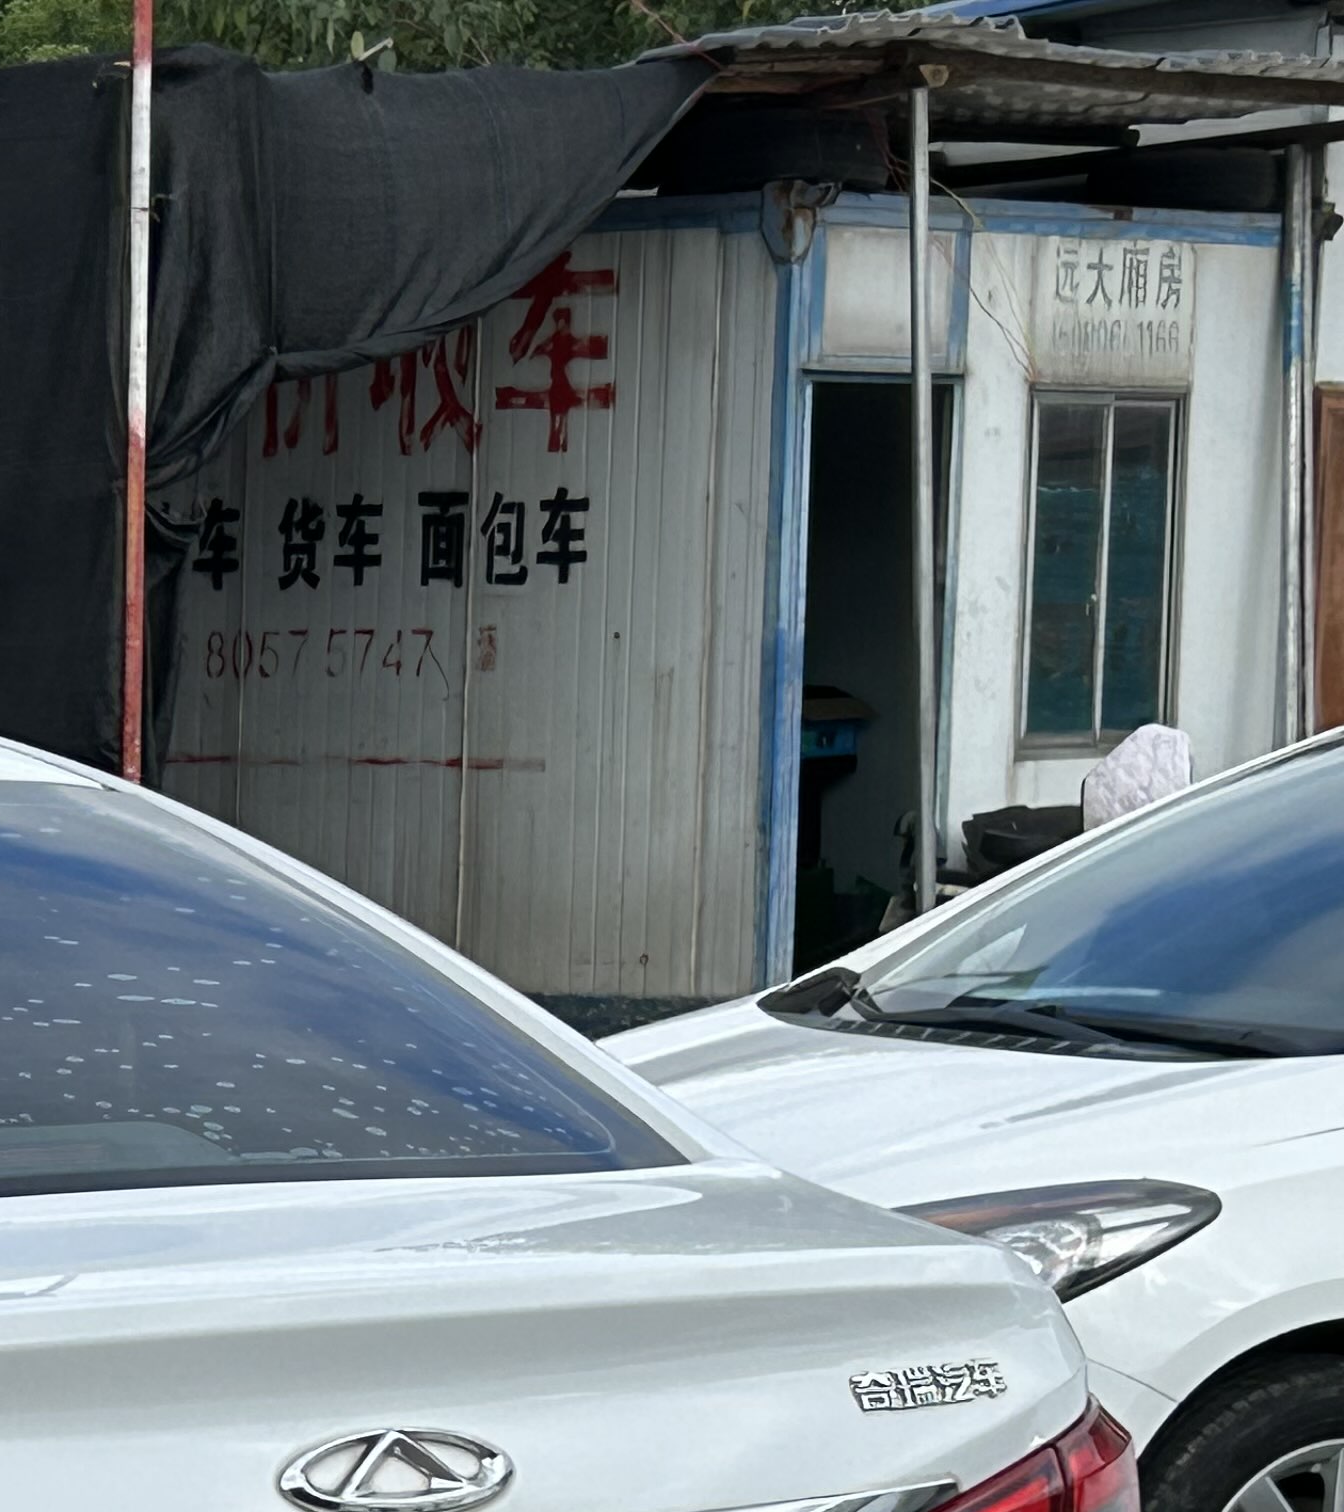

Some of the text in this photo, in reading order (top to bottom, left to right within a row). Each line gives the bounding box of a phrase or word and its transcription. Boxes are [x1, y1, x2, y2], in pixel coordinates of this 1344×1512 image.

[1055, 244, 1183, 311] 远大厢房
[277, 493, 383, 590] 货车
[417, 487, 591, 588] 面包车
[849, 1359, 1008, 1413] 奇瑞汽车
